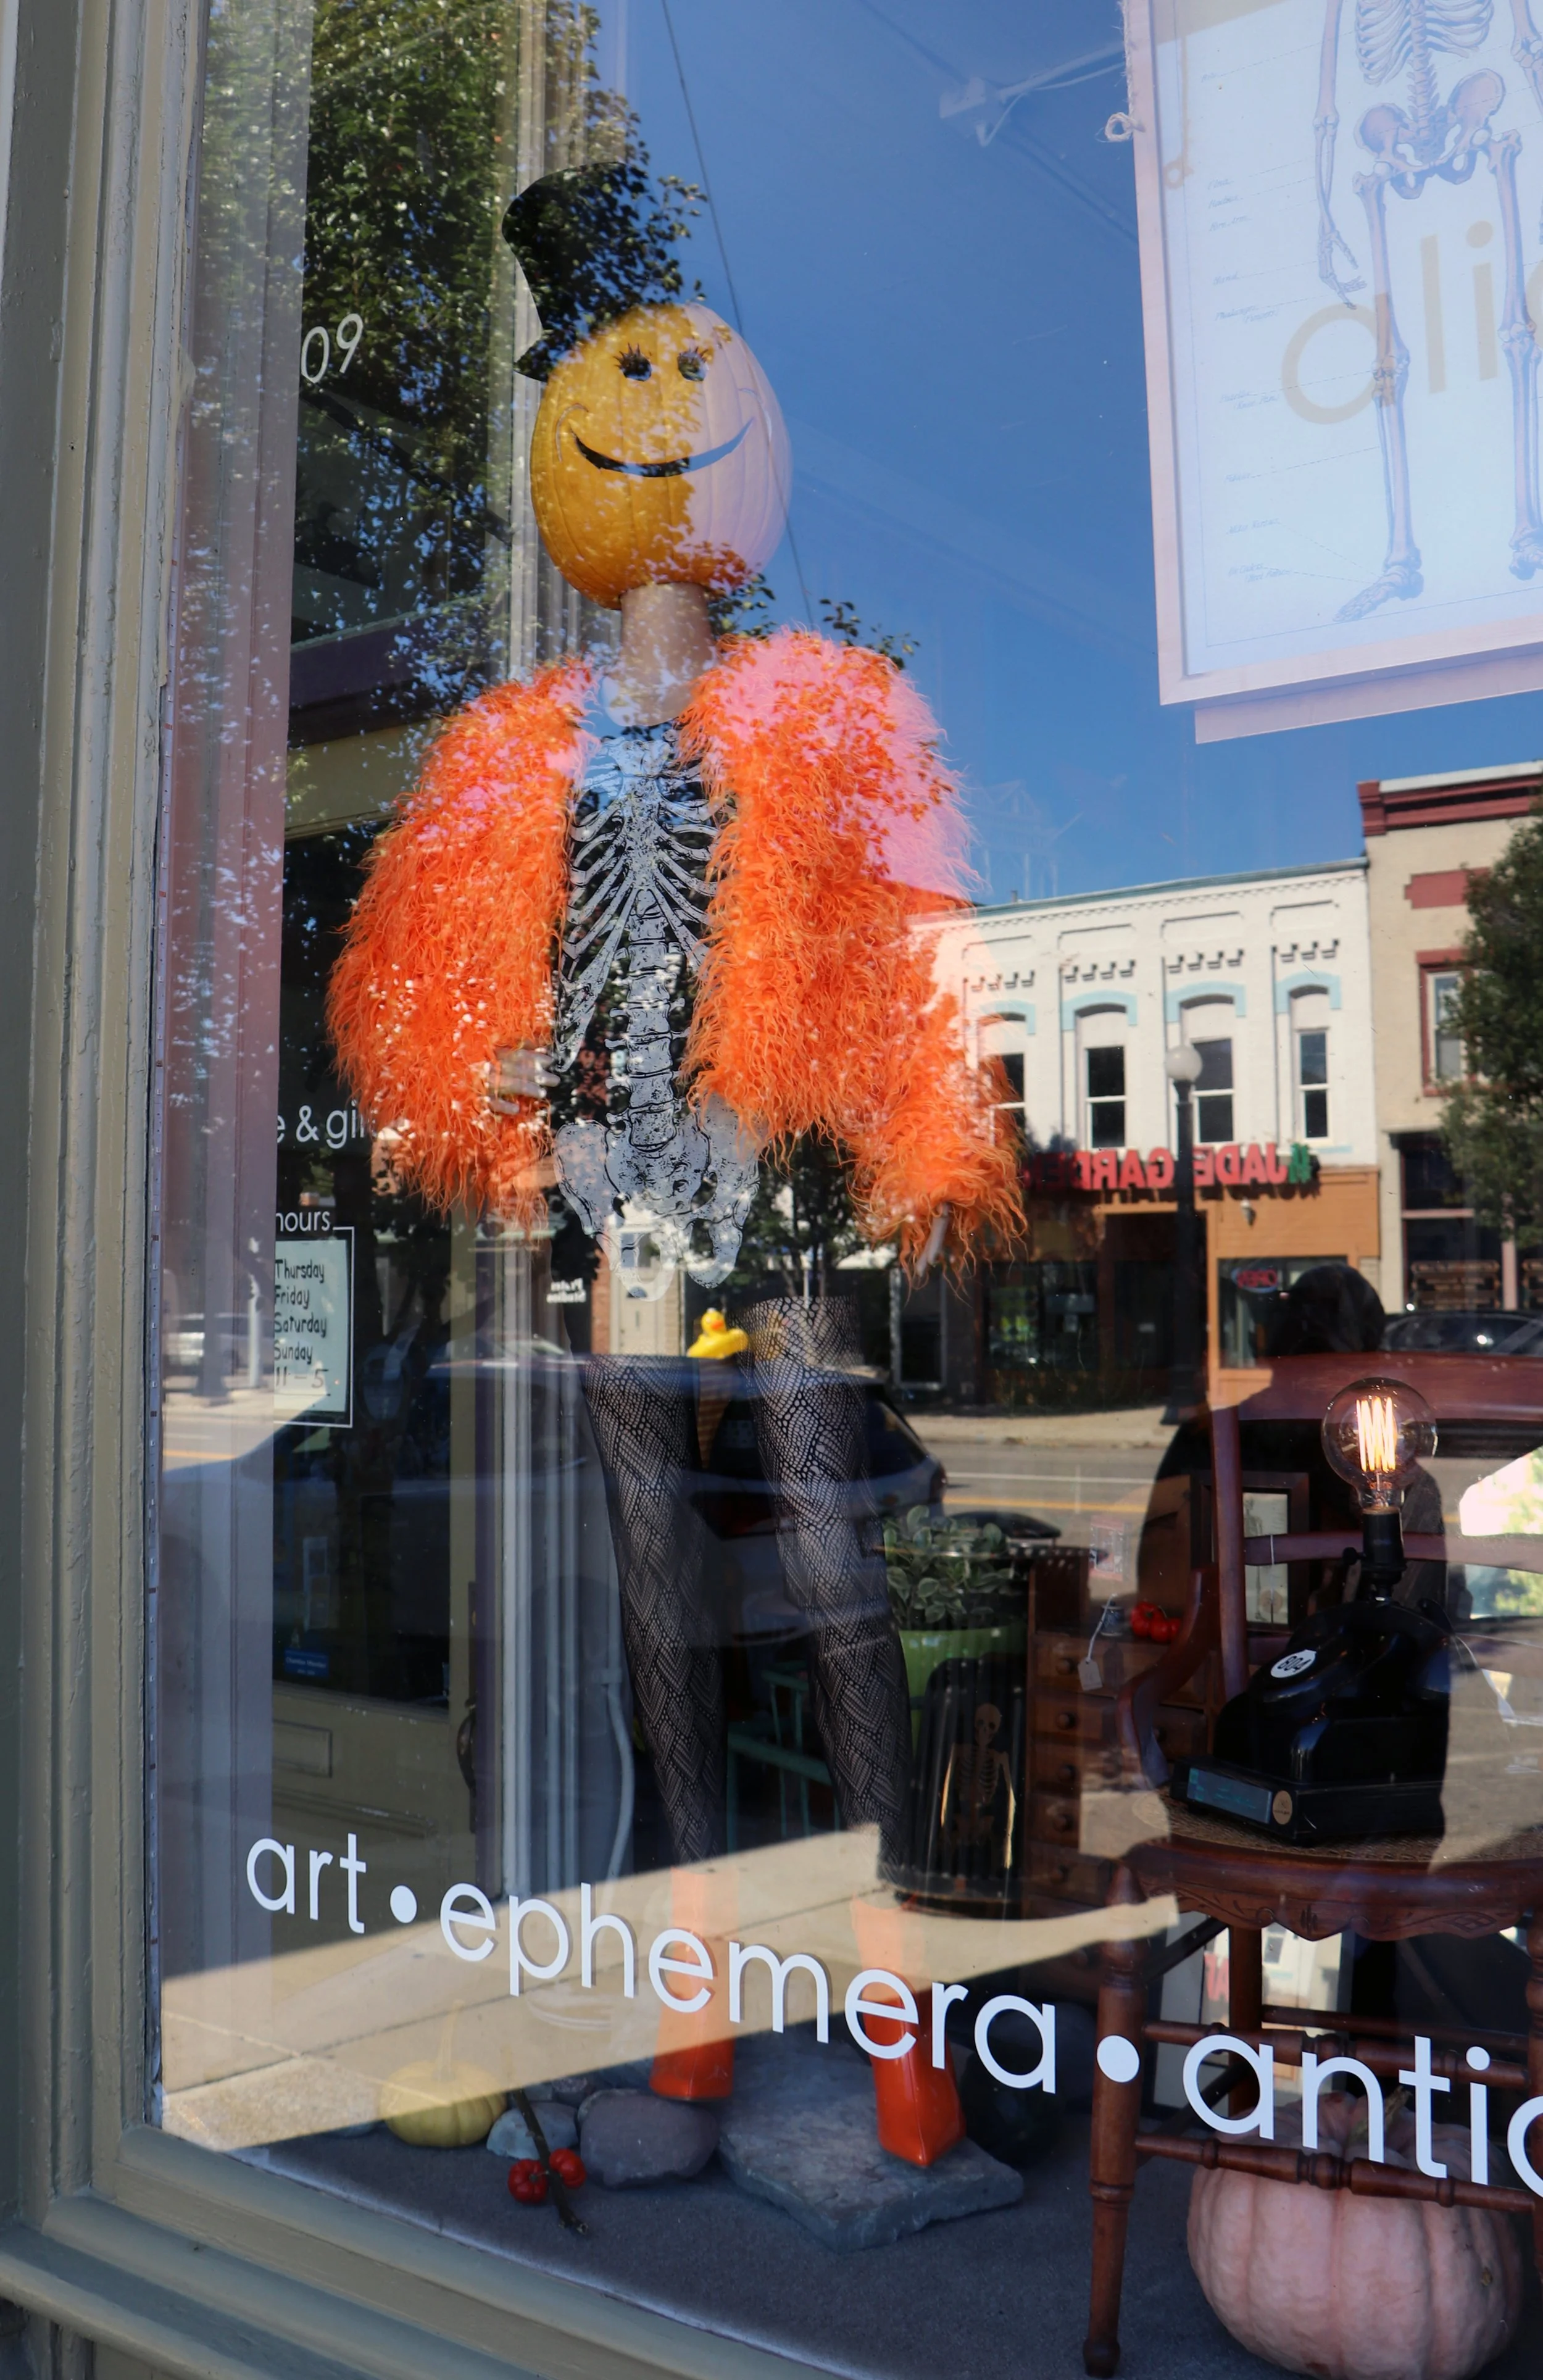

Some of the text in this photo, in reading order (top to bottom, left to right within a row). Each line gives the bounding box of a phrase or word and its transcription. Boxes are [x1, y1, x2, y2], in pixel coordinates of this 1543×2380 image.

[1282, 220, 1543, 425] ali
[296, 1105, 319, 1142] &
[275, 1259, 325, 1284] Thursday
[275, 1286, 310, 1310] Friday
[274, 1312, 327, 1338] Saturday
[273, 1339, 313, 1365] Sunday
[246, 1833, 367, 1934] art
[440, 1883, 1056, 2094] ephemera
